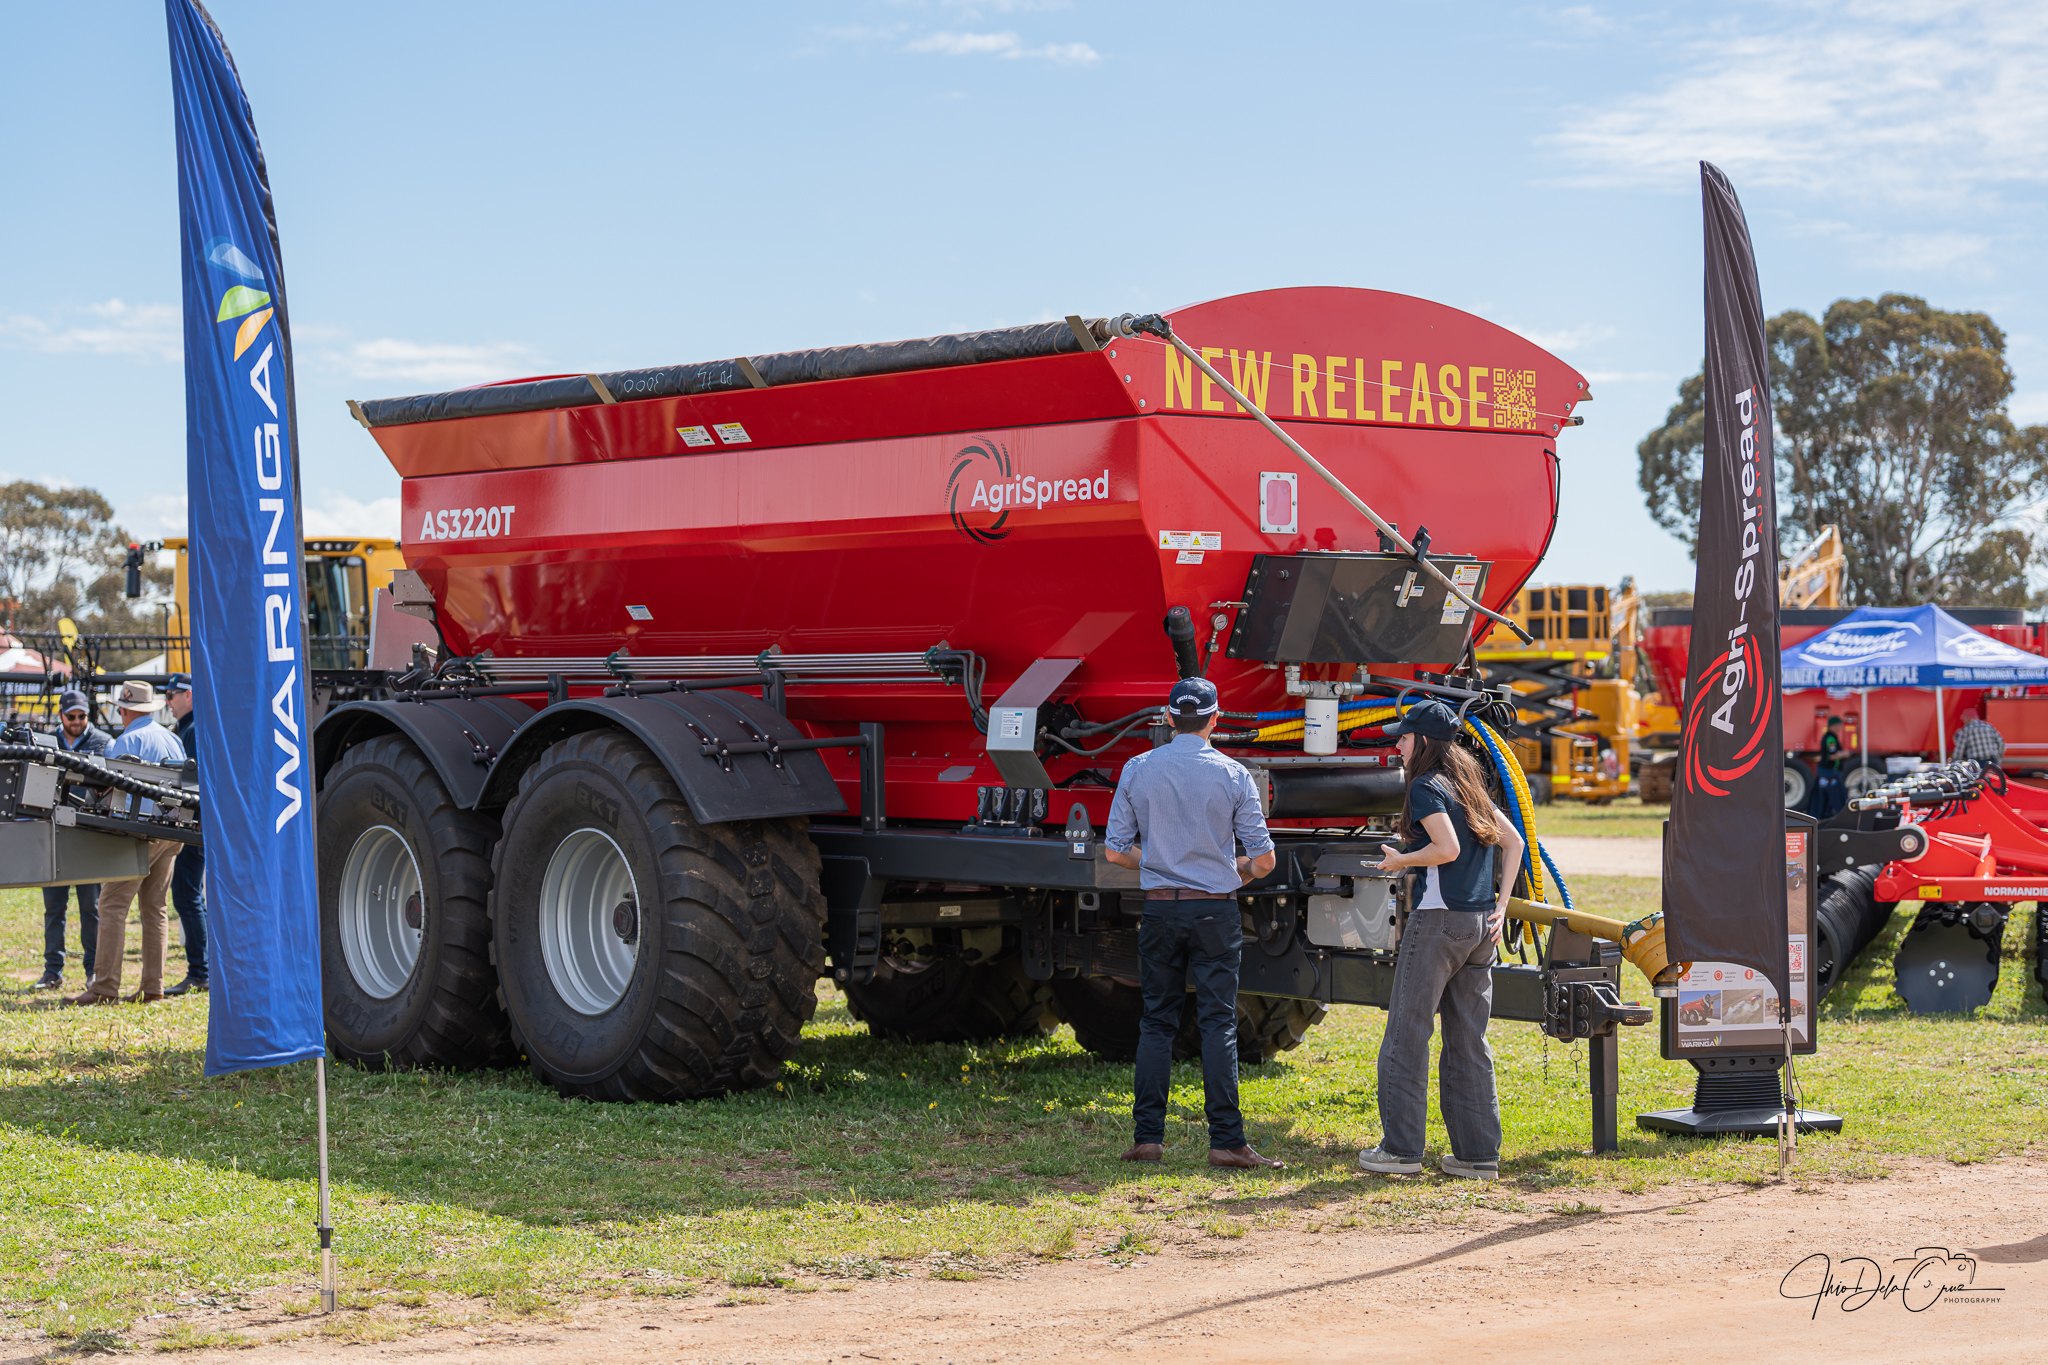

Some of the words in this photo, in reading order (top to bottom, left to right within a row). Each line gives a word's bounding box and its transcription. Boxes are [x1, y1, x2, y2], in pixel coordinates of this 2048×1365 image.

[1165, 344, 1272, 413] NEW
[1292, 353, 1490, 428] RELEASE
[1752, 384, 1763, 534] AUSTRALIA
[970, 469, 1109, 513] AgriSpread
[420, 505, 515, 540] AS3220T
[1710, 388, 1760, 735] Agri-Spread
[250, 341, 302, 834] WARINGA
[1822, 666, 1866, 685] SERVICE
[1867, 666, 1877, 685] &
[1878, 665, 1919, 685] PEOPLE
[373, 785, 407, 825] BKT
[576, 785, 617, 824] BKT
[1984, 886, 2048, 896] NORMANDIE
[1681, 1040, 1715, 1048] WARINGA
